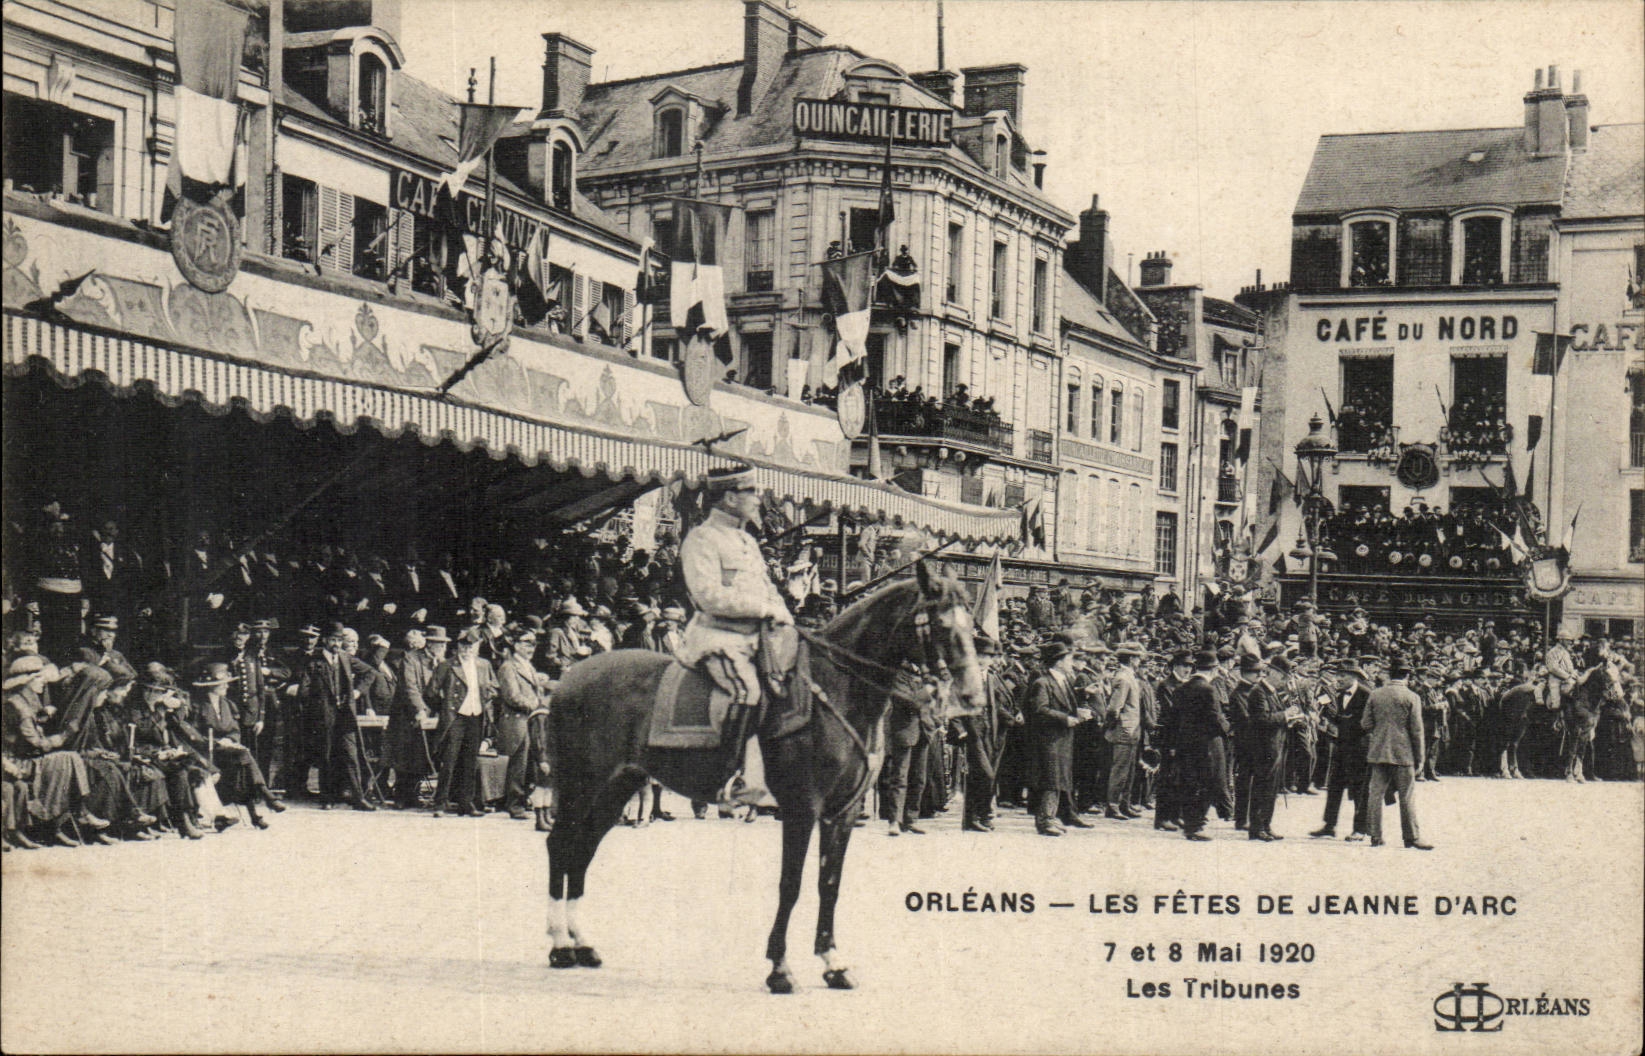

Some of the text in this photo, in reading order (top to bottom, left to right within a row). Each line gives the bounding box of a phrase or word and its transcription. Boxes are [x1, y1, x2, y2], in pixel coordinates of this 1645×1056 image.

[795, 102, 951, 142] QUINCAILLERIE
[397, 171, 442, 218] CAF
[1316, 310, 1517, 341] CAFÉ DU NORD
